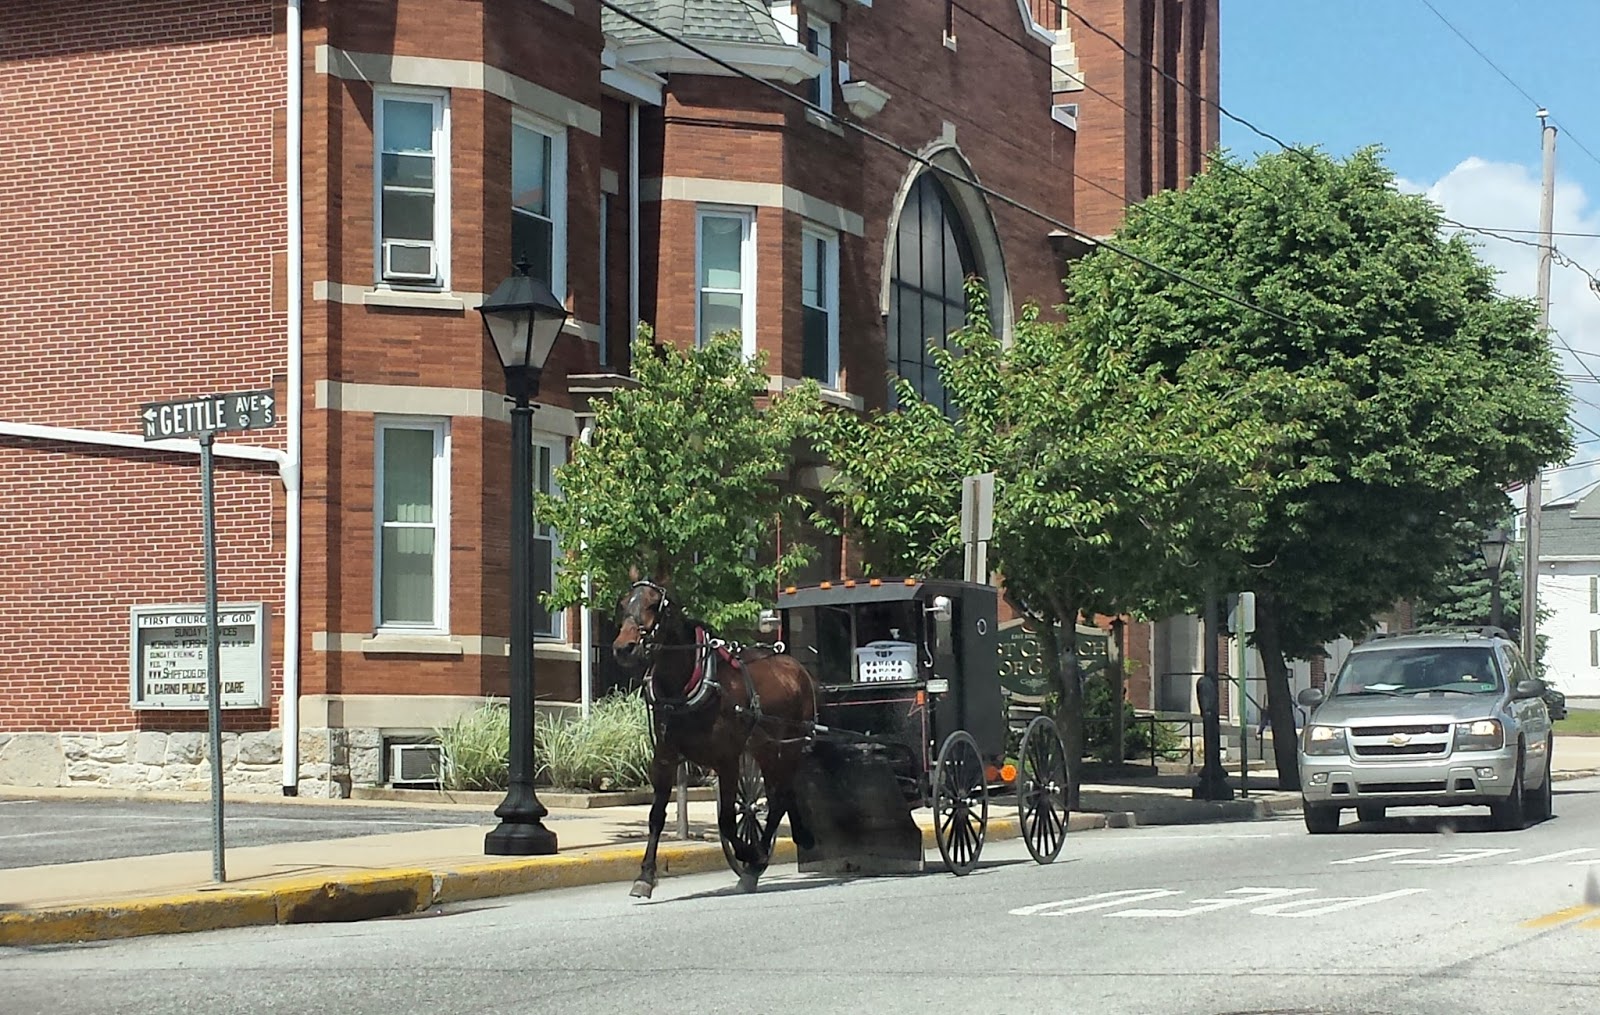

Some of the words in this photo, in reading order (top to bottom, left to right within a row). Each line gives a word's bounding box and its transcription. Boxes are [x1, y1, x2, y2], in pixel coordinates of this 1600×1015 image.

[160, 400, 228, 435] GETTLE
[235, 395, 260, 413] AVE
[264, 409, 272, 423] S
[146, 422, 156, 437] N
[143, 616, 171, 626] FIRST
[174, 615, 207, 624] CHURC
[232, 613, 252, 623] GOD
[174, 628, 201, 638] SUNDAY
[146, 683, 152, 695] A
[154, 683, 180, 695] CARING
[181, 682, 206, 695] PLACE
[224, 681, 245, 693] CARE
